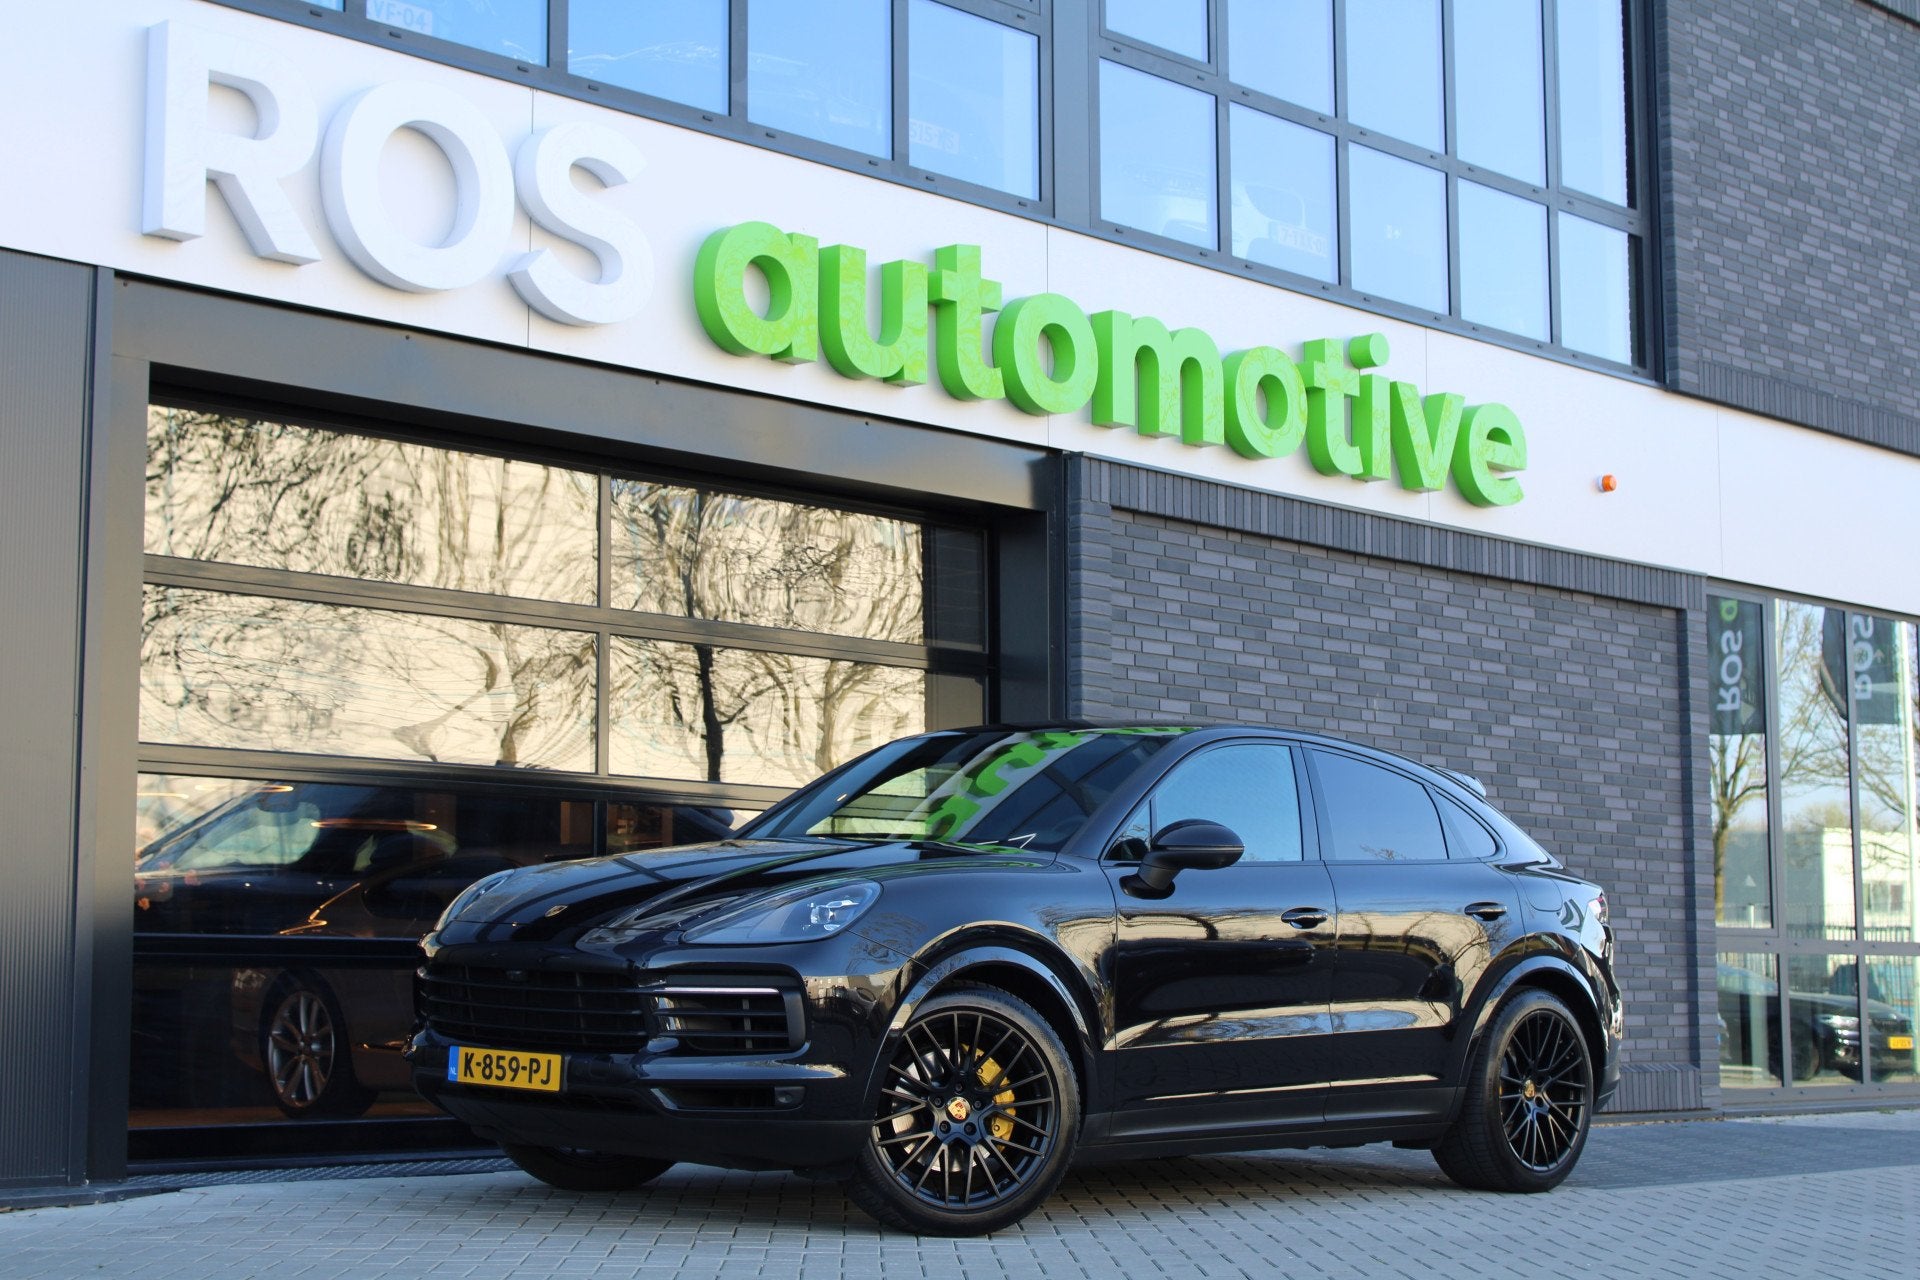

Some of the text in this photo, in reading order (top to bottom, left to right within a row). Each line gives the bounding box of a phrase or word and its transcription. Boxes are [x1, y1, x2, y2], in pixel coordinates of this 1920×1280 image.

[141, 19, 1527, 507] ROS automotive
[463, 1051, 552, 1086] K-859-PJ
